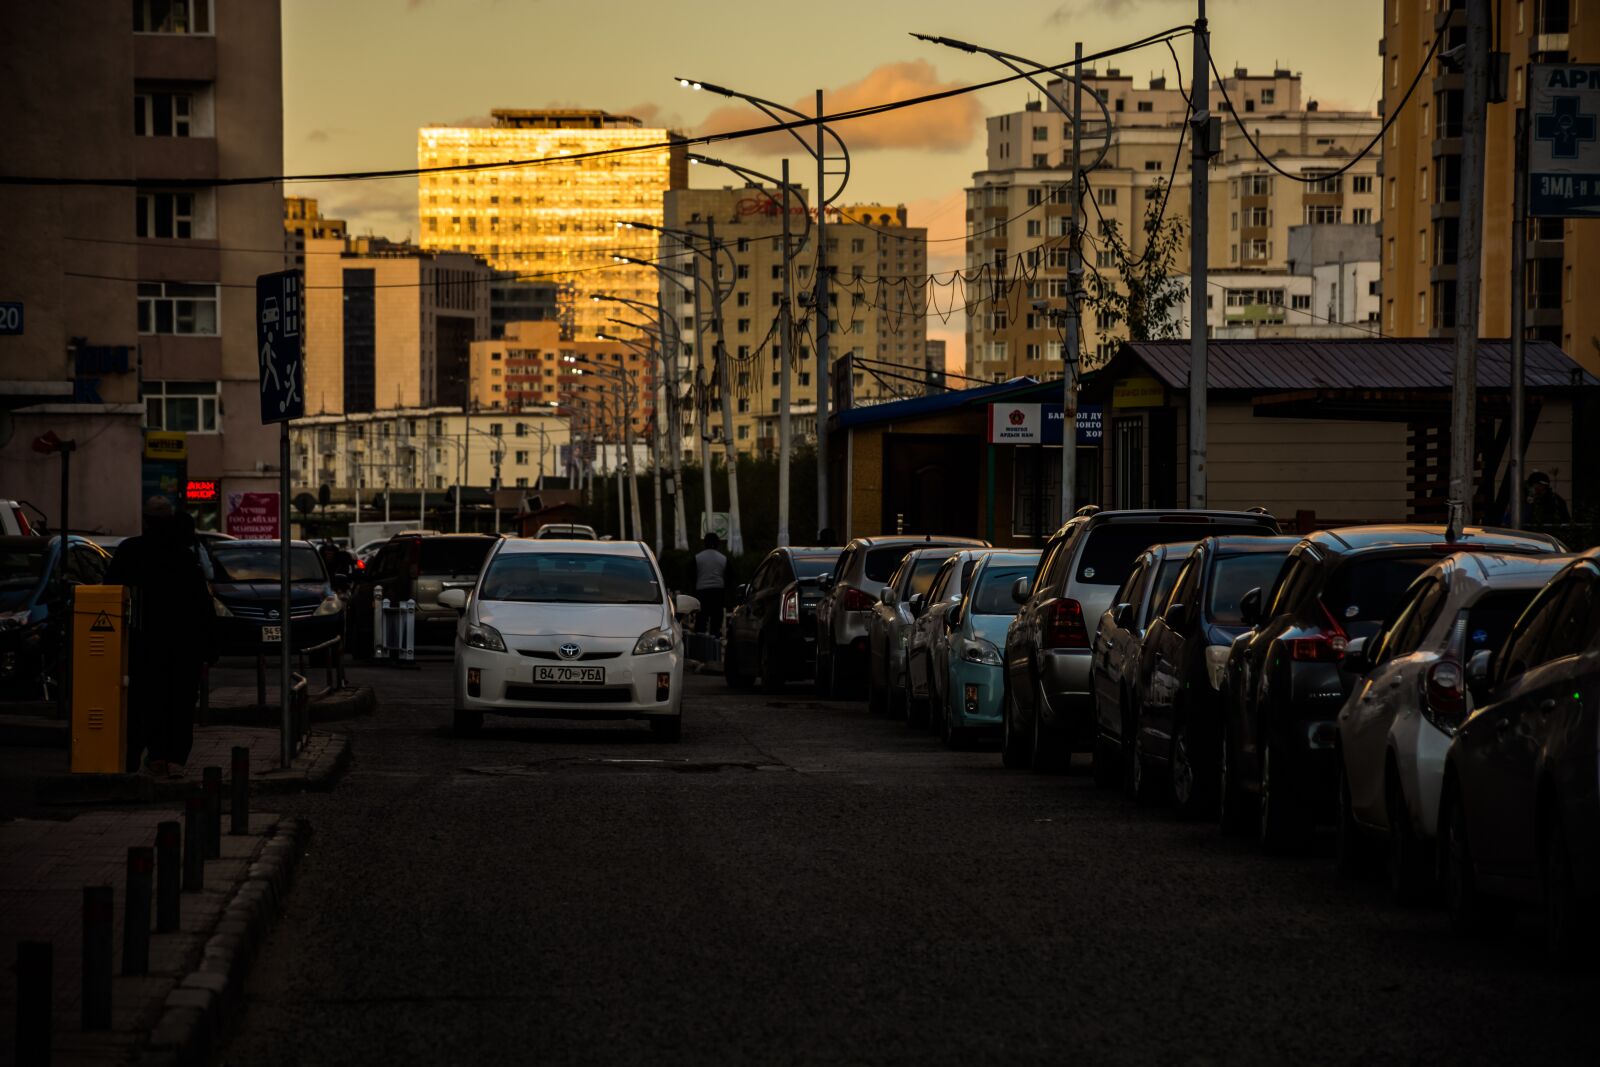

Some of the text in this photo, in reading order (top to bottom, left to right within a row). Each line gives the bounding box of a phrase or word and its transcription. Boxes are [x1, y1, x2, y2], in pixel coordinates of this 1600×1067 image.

[1048, 412, 1088, 420] БАЯОЛ
[540, 668, 554, 679] 84
[557, 668, 572, 679] 70
